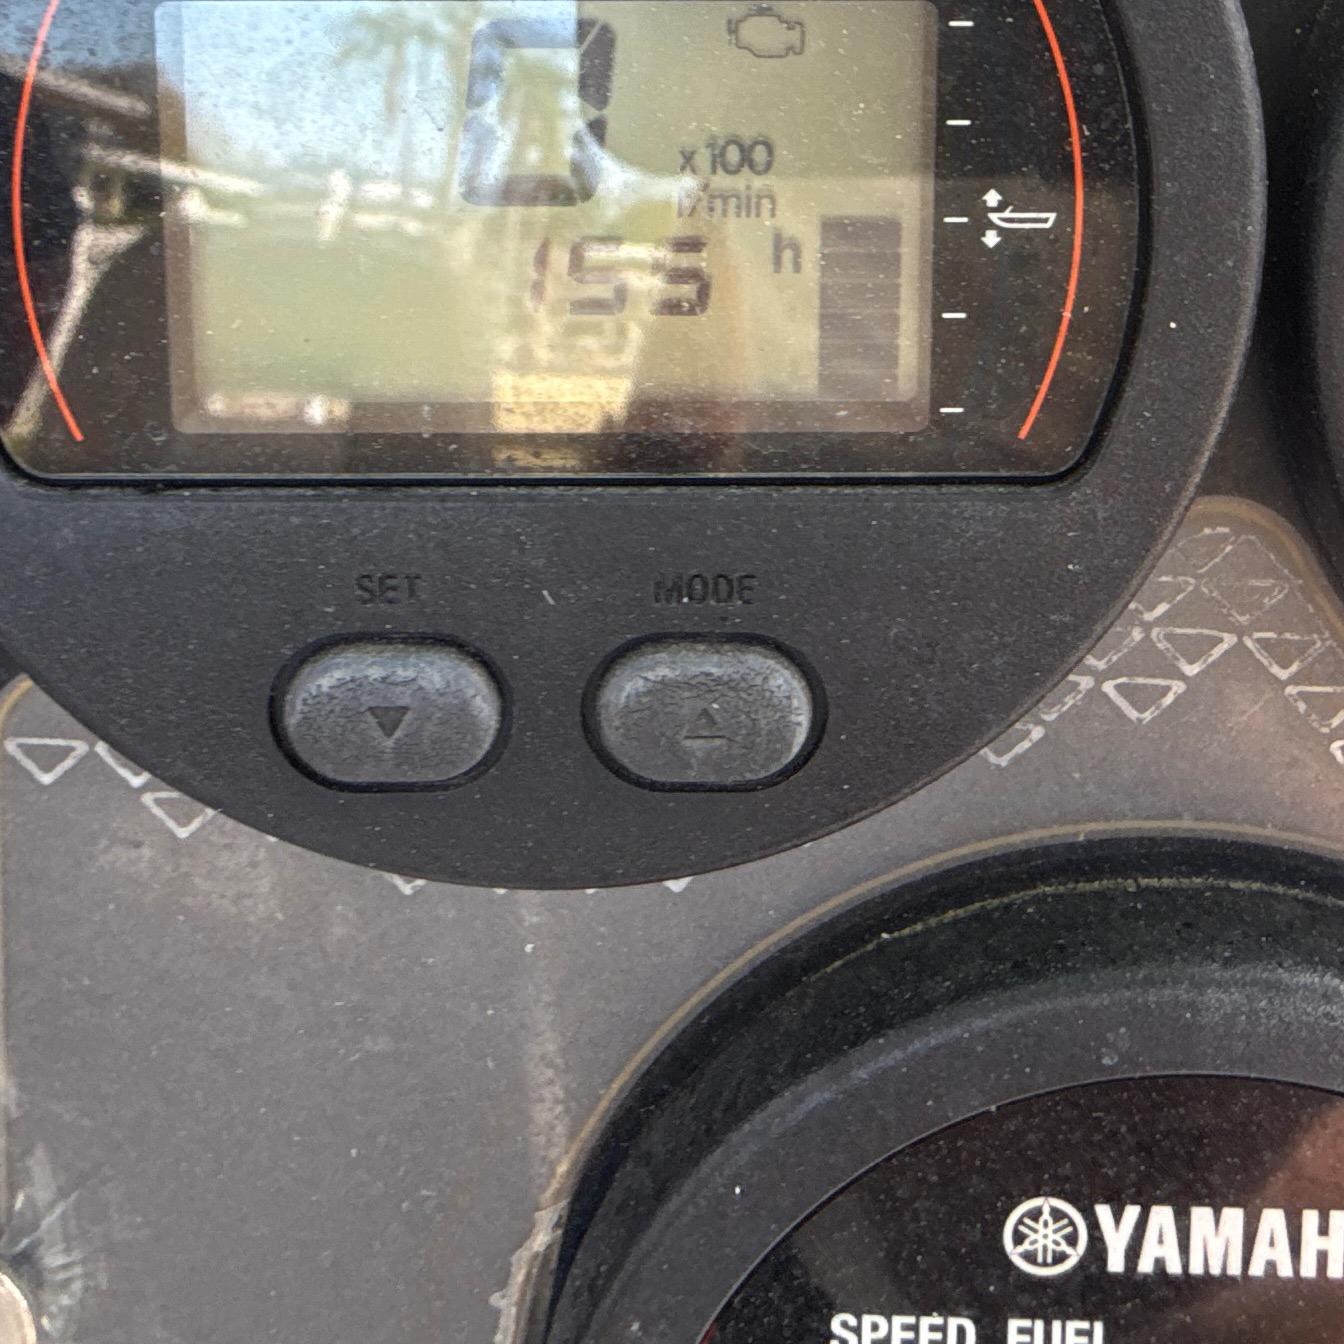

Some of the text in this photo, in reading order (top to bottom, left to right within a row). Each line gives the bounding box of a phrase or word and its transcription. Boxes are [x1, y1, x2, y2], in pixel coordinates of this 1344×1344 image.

[771, 227, 803, 274] h
[357, 574, 422, 606] SET
[655, 573, 757, 605] MODE
[830, 1313, 976, 1344] SPEED
